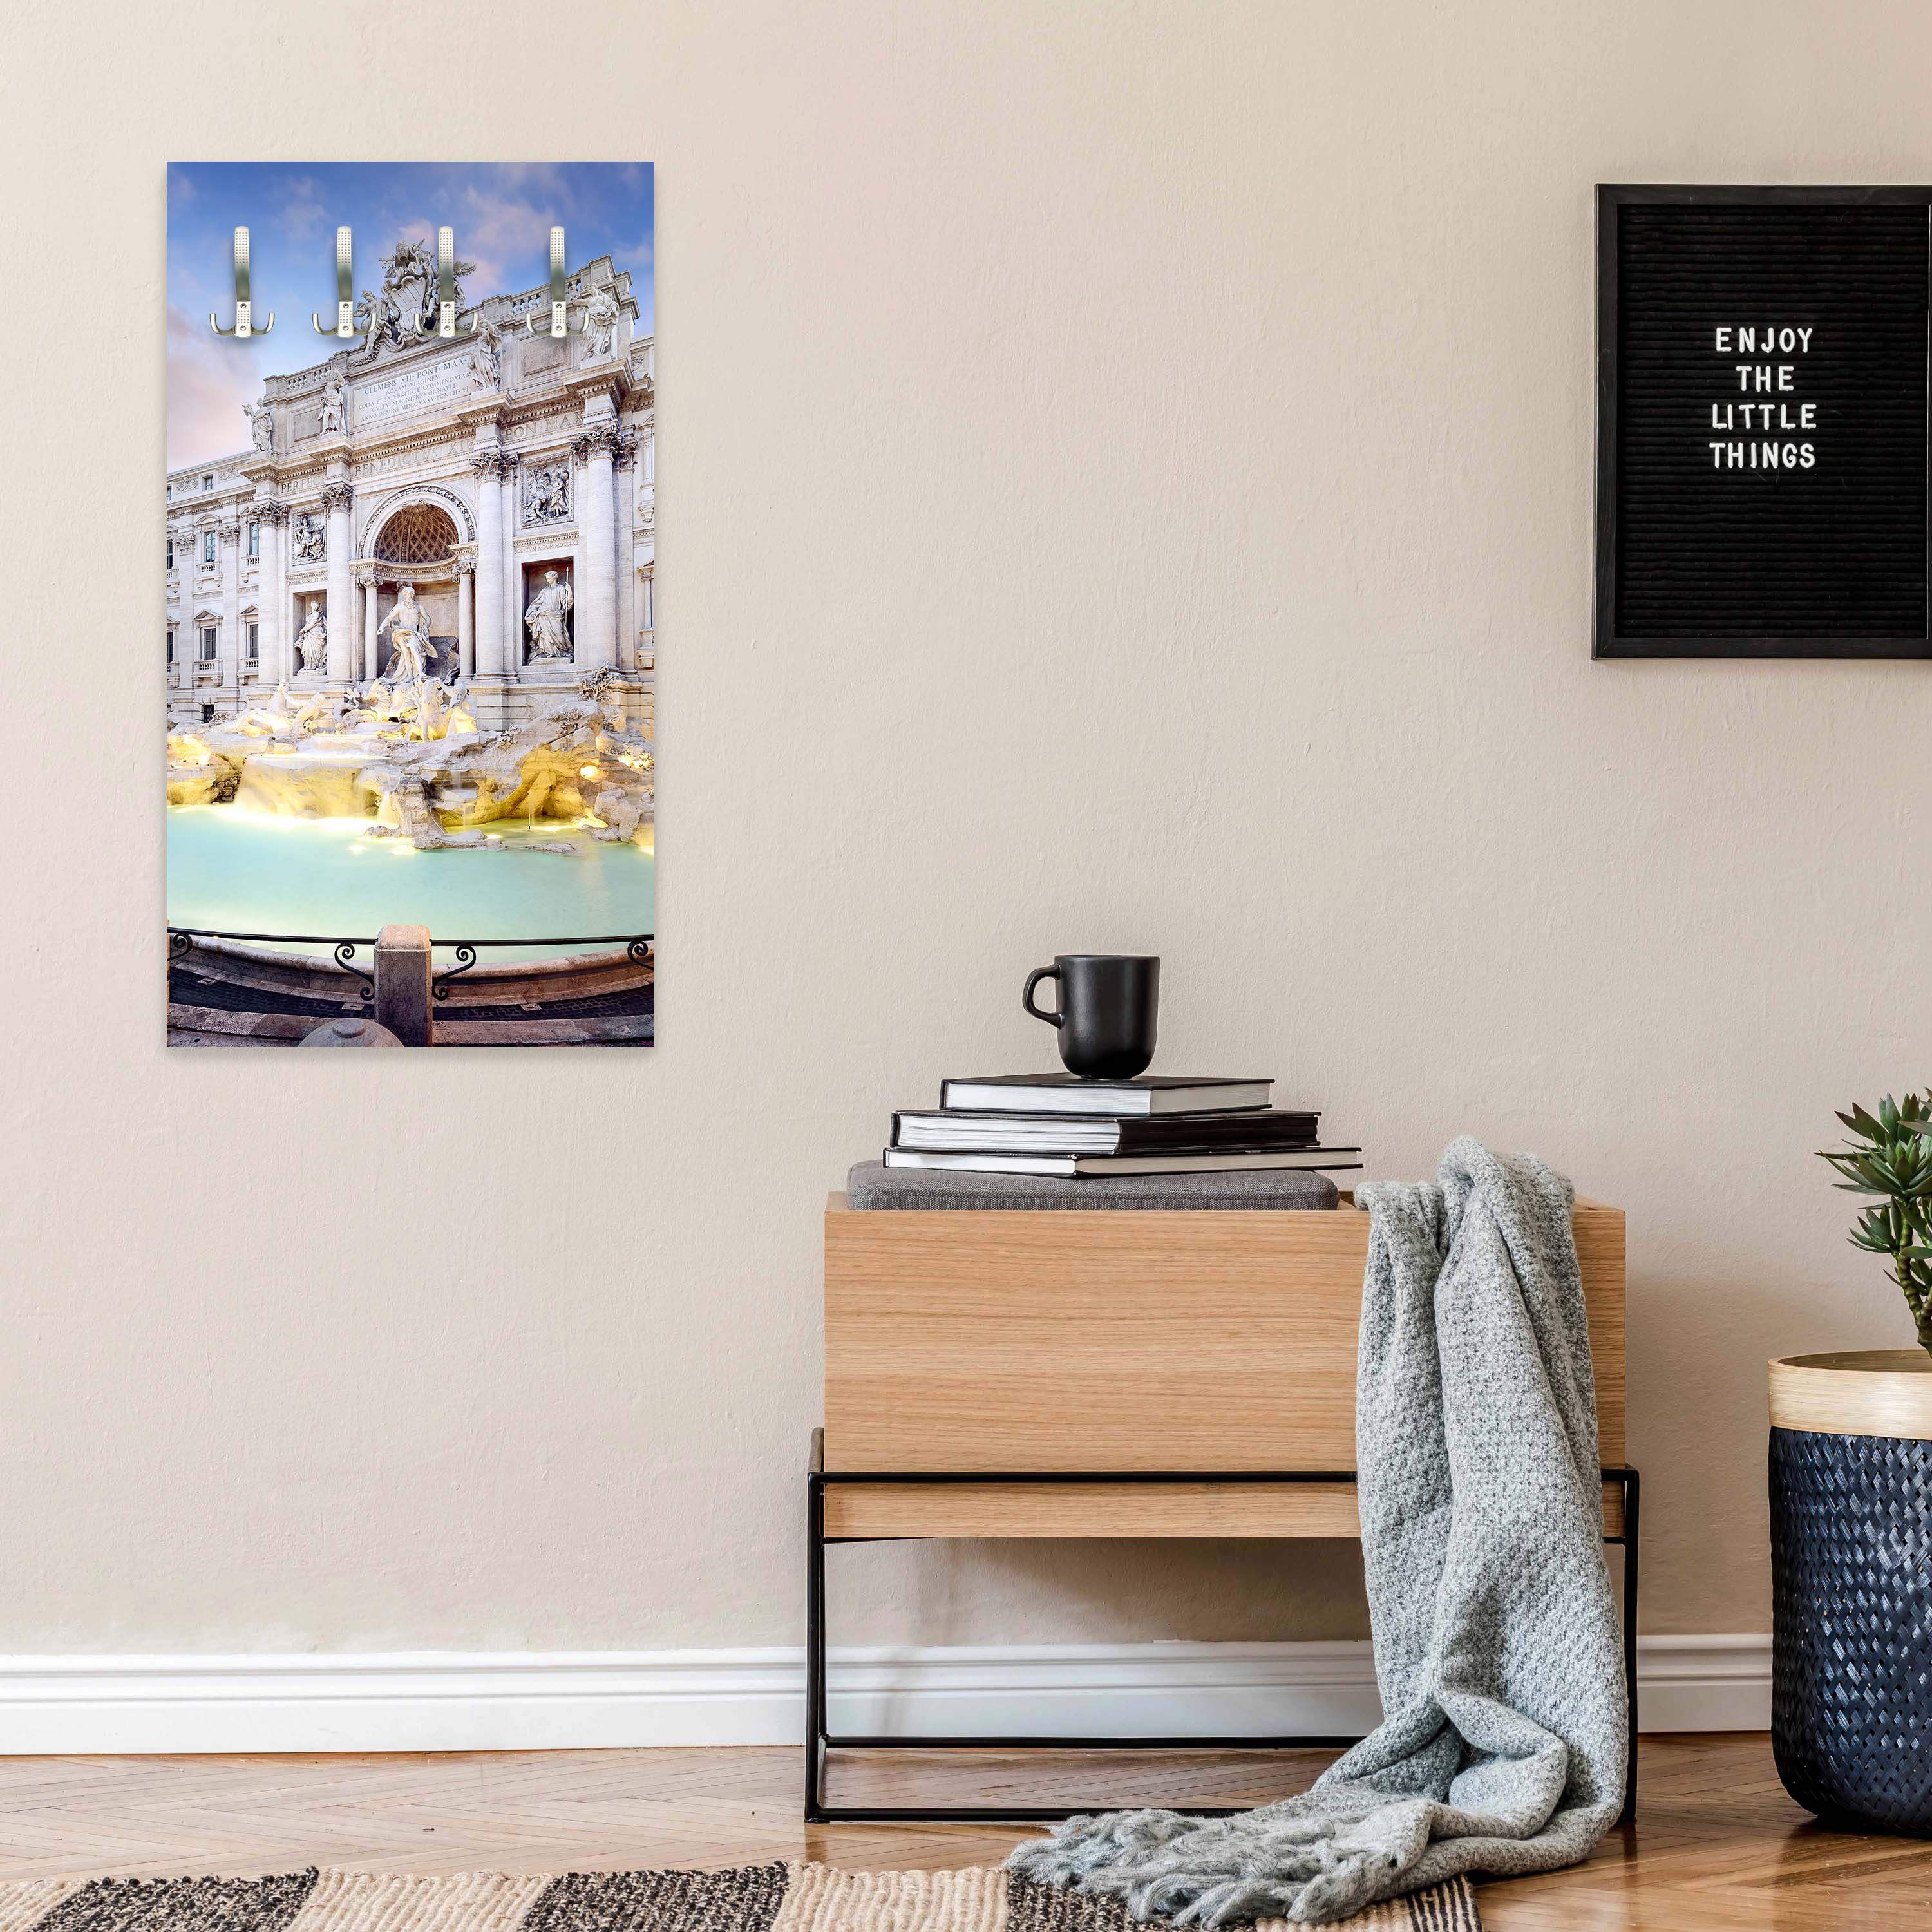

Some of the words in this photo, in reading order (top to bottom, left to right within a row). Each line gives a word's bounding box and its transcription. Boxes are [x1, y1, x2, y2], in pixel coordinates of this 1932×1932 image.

[1716, 327, 1814, 354] ENJOY
[364, 381, 397, 395] CLEMENS
[1735, 365, 1795, 392] THE
[1712, 403, 1817, 430] LITTLE
[1709, 442, 1816, 469] THINGS
